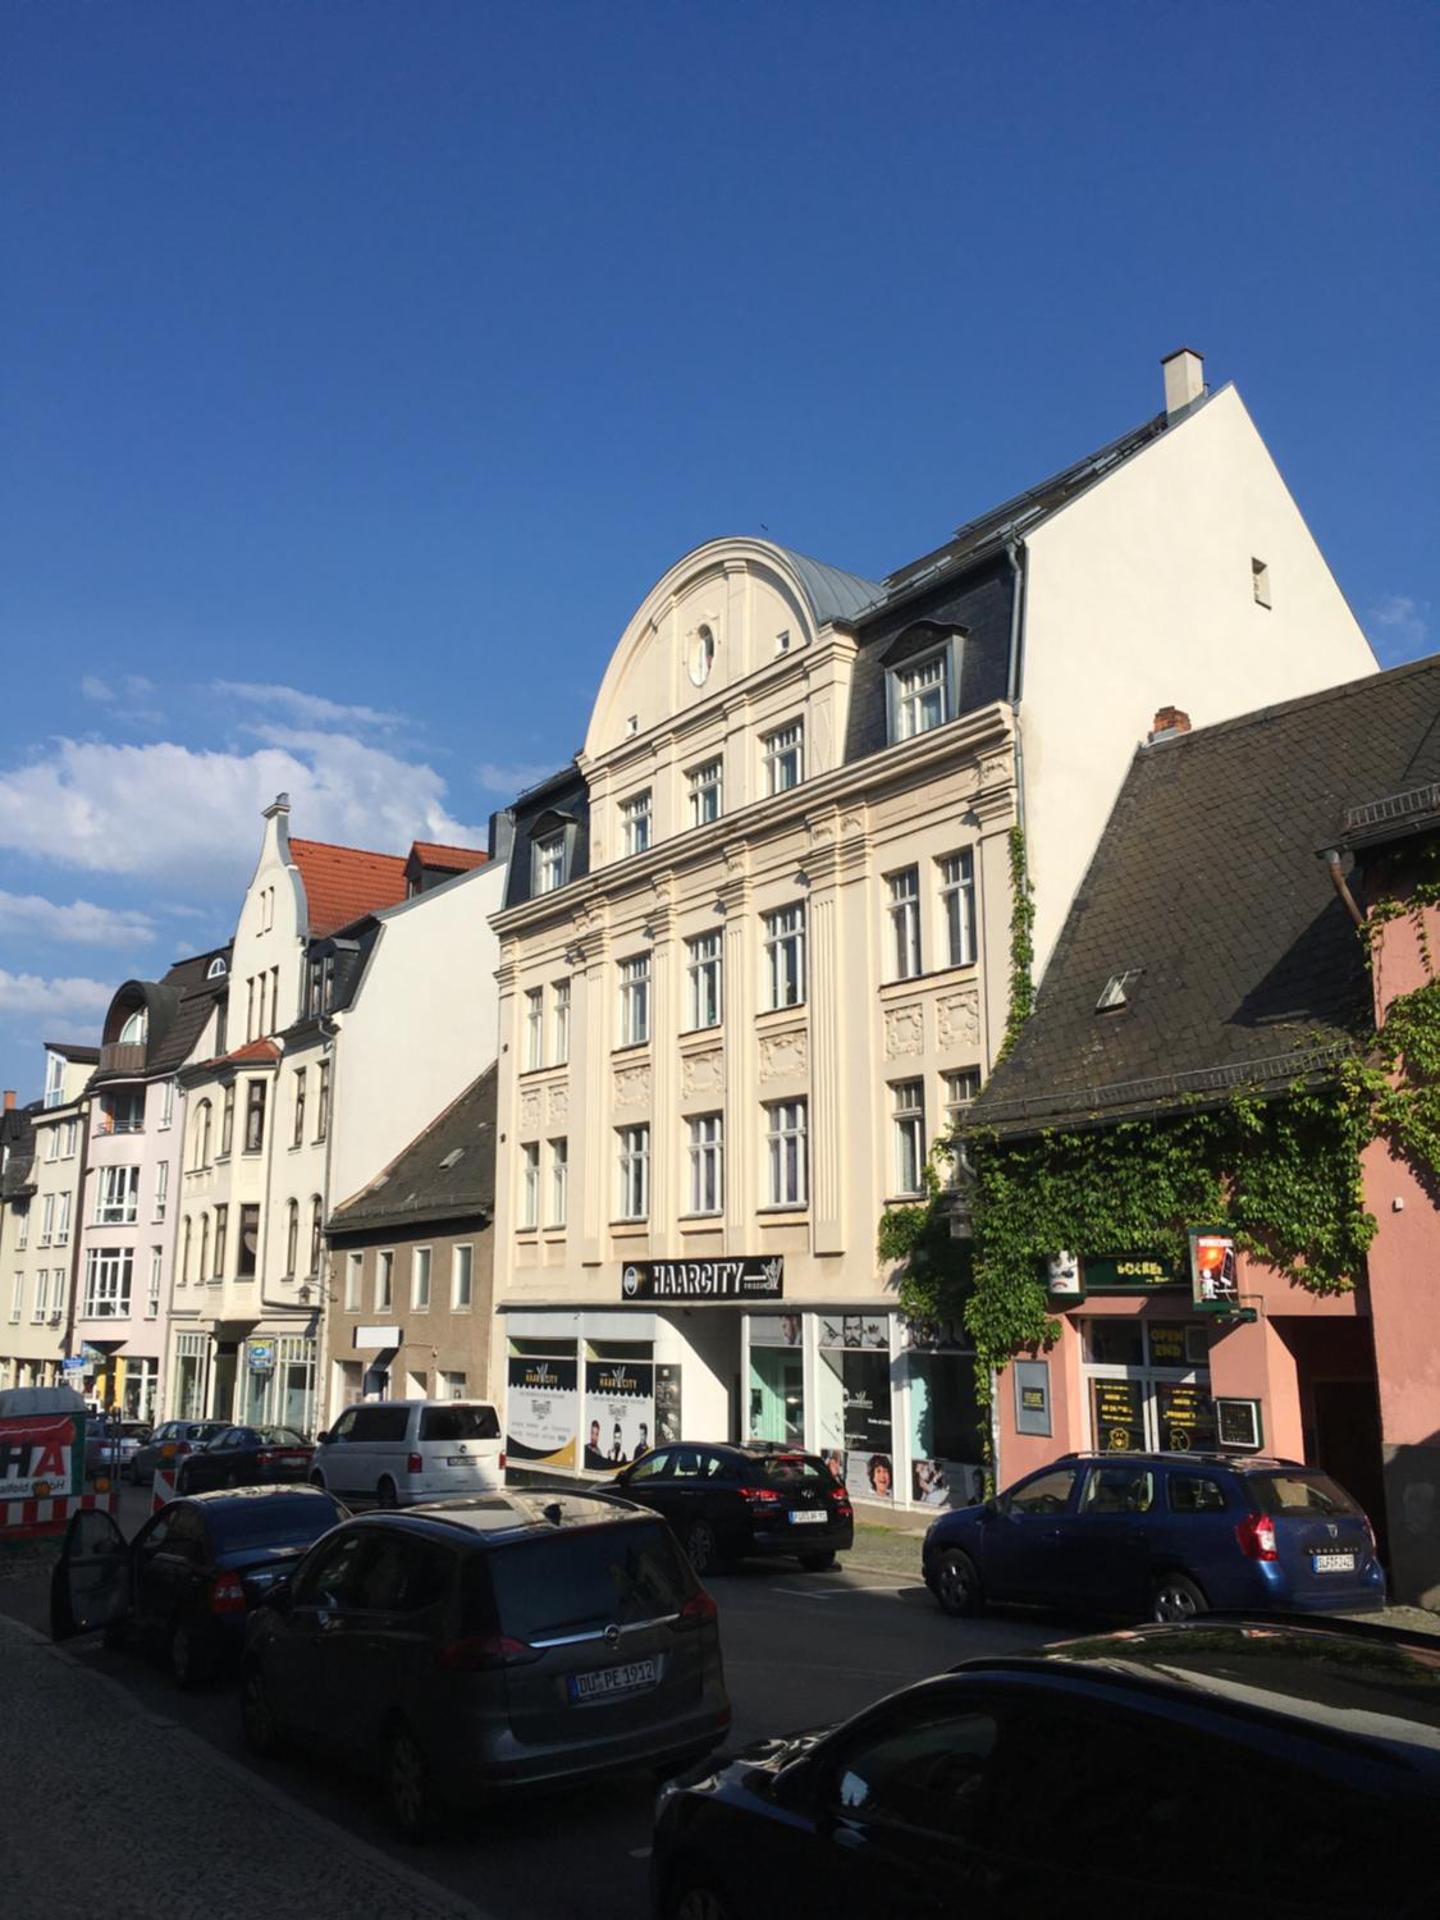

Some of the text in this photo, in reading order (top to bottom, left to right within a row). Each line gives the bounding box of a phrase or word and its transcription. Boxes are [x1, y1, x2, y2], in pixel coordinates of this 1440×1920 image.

[653, 1262, 745, 1294] HAARCITY
[604, 1669, 621, 1688] PE
[623, 1662, 654, 1683] 1912
